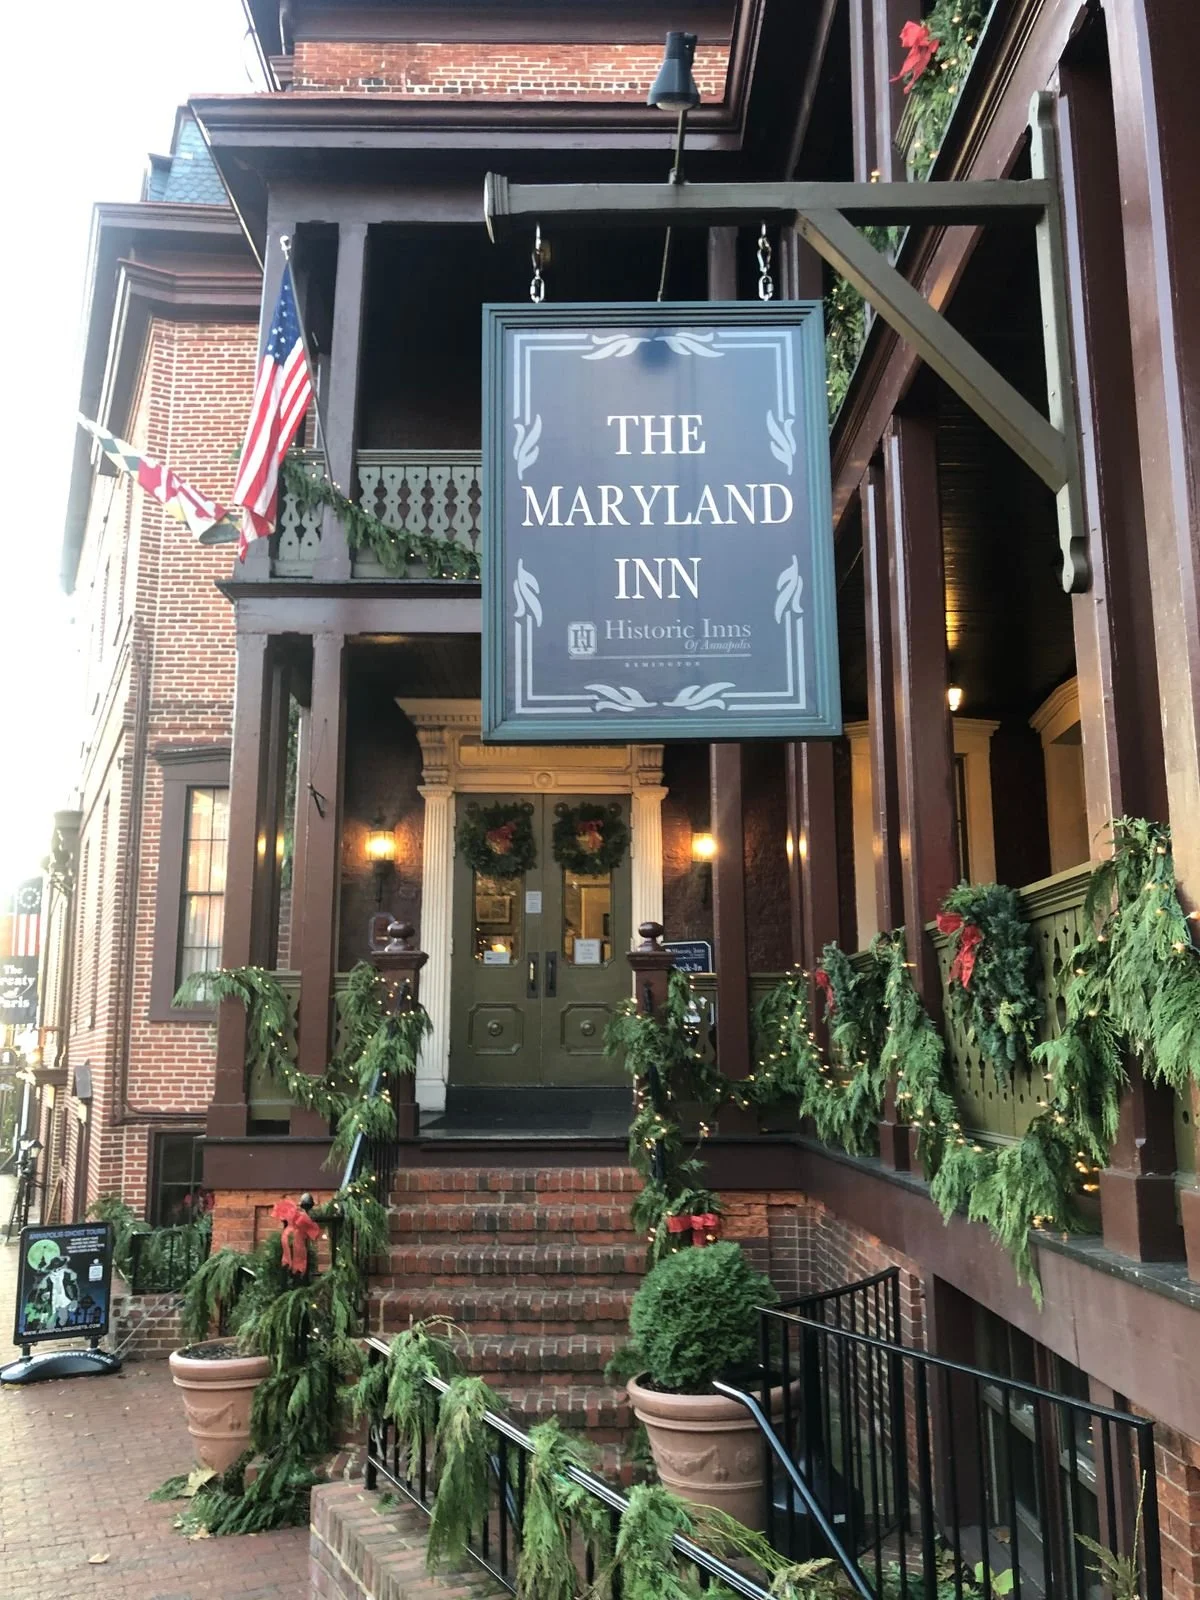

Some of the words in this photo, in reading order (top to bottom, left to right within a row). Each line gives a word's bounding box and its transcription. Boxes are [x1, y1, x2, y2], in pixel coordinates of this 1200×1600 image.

[607, 414, 706, 455] THE
[521, 483, 794, 527] MARYLAND
[613, 557, 702, 600] INN
[605, 619, 695, 640] Historic
[702, 618, 751, 638] Inns
[684, 640, 699, 653] Of
[700, 638, 751, 653] Annapolis
[3, 964, 23, 975] The
[0, 976, 36, 995] reaty
